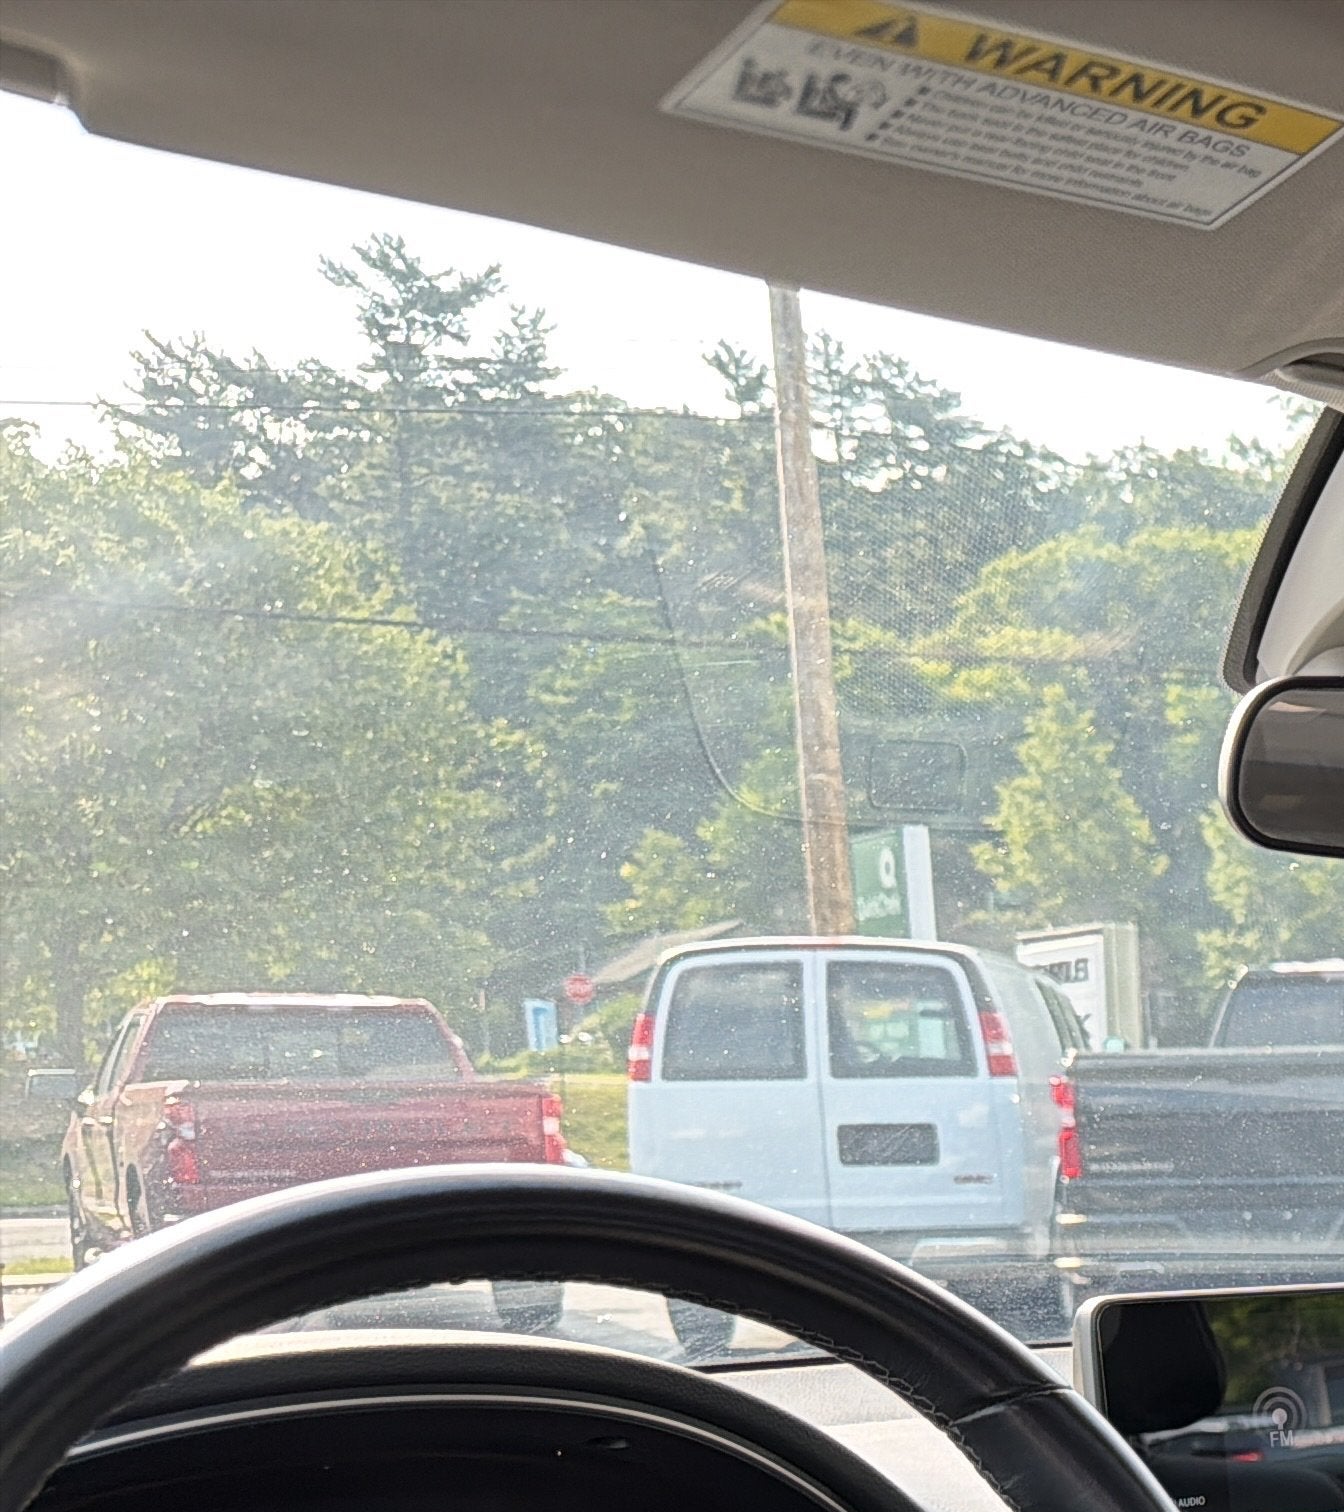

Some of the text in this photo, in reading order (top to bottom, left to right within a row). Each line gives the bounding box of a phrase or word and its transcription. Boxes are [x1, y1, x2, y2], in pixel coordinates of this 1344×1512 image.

[806, 38, 1251, 158] EVEN WITH ADVANCED AIR BAGS
[963, 33, 1268, 131] WARNING
[1269, 1431, 1295, 1448] FM
[1178, 1496, 1206, 1508] AUDIO
